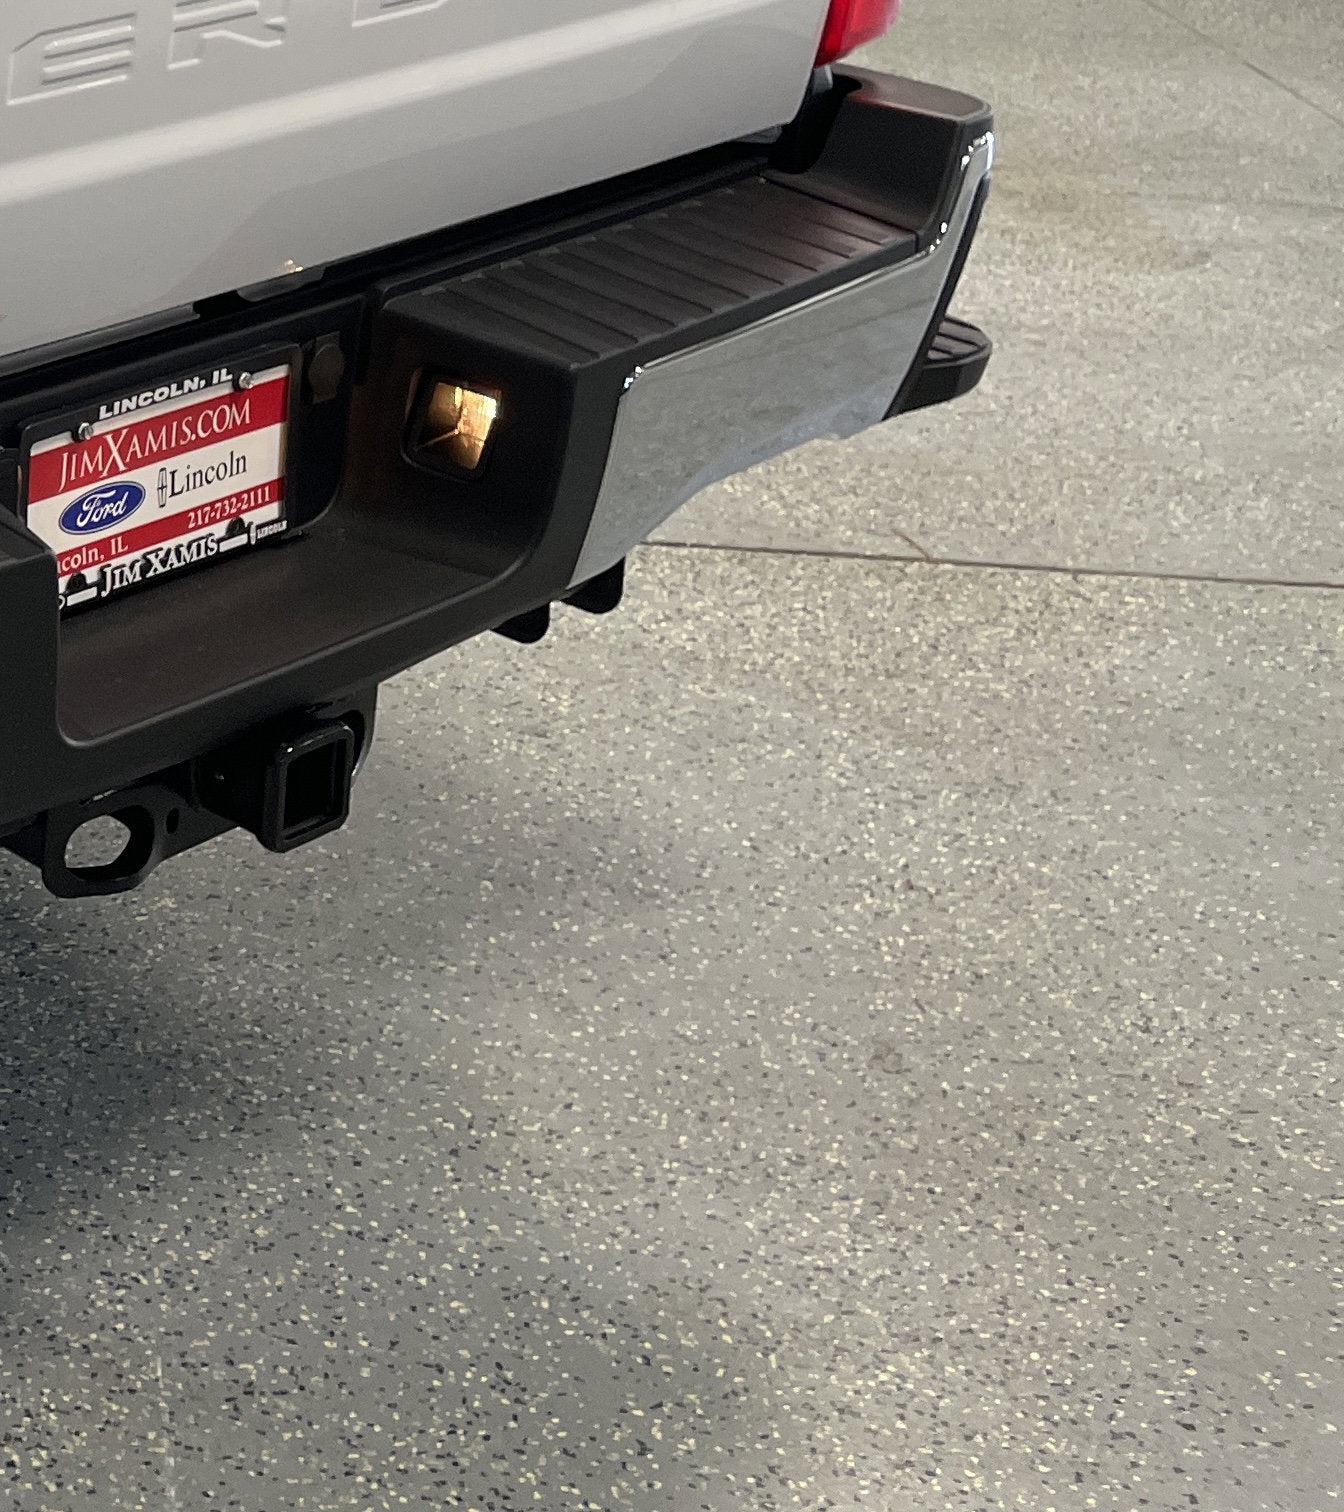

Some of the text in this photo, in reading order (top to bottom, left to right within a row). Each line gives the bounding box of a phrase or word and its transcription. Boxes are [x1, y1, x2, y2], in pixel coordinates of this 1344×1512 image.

[99, 368, 233, 420] LINCOLN, IL
[169, 451, 248, 499] Lincoln
[76, 490, 129, 528] Ford
[188, 485, 270, 529] 217-732-2111
[58, 535, 129, 573] coln, IL
[101, 536, 218, 597] JIM XAMIS
